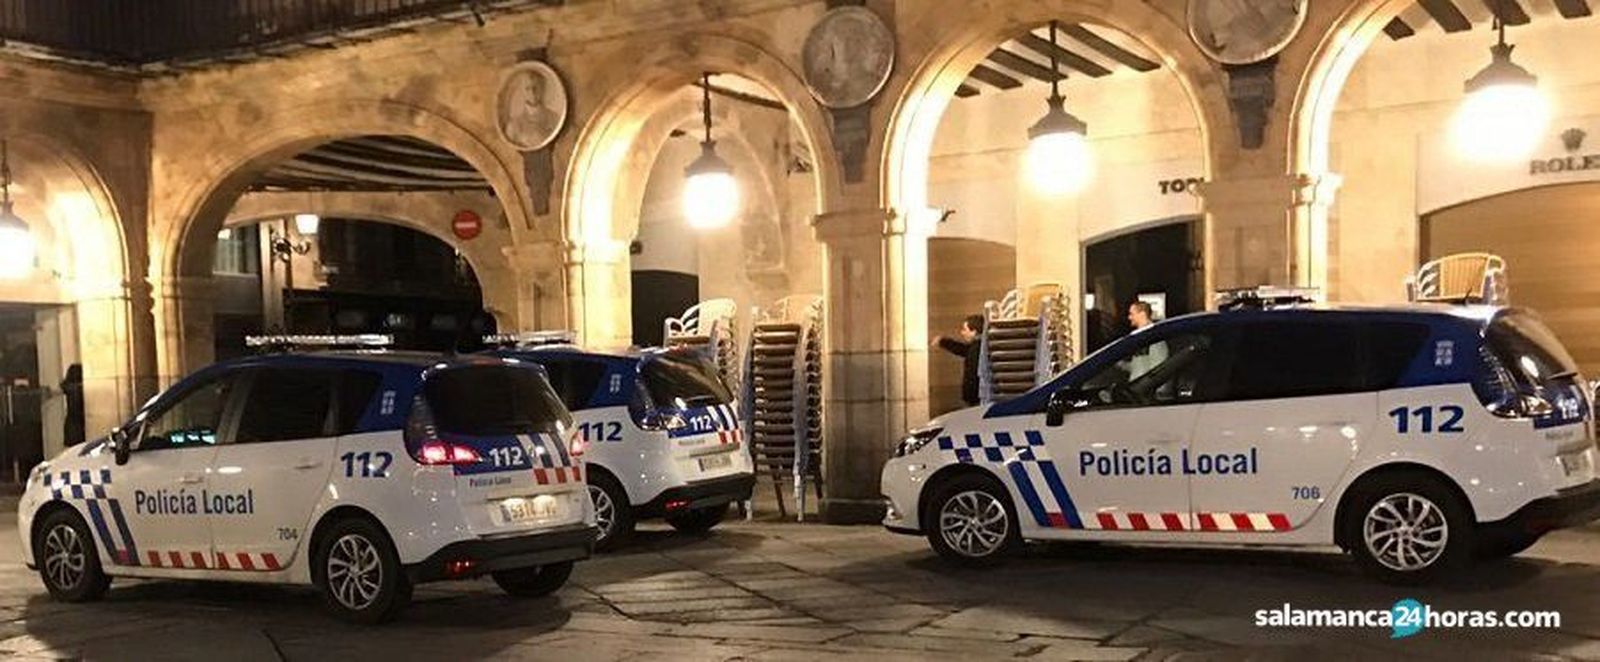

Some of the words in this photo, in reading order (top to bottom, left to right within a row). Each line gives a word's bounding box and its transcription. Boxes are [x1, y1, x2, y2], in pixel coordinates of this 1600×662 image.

[689, 415, 712, 431] 112
[1388, 405, 1464, 433] 112
[579, 421, 622, 442] 112
[341, 451, 394, 478] 112
[489, 446, 524, 467] 112
[1079, 448, 1172, 477] Policía
[1182, 447, 1258, 475] Local
[135, 489, 198, 515] Policía
[202, 489, 254, 514] Local
[277, 528, 299, 541] 704
